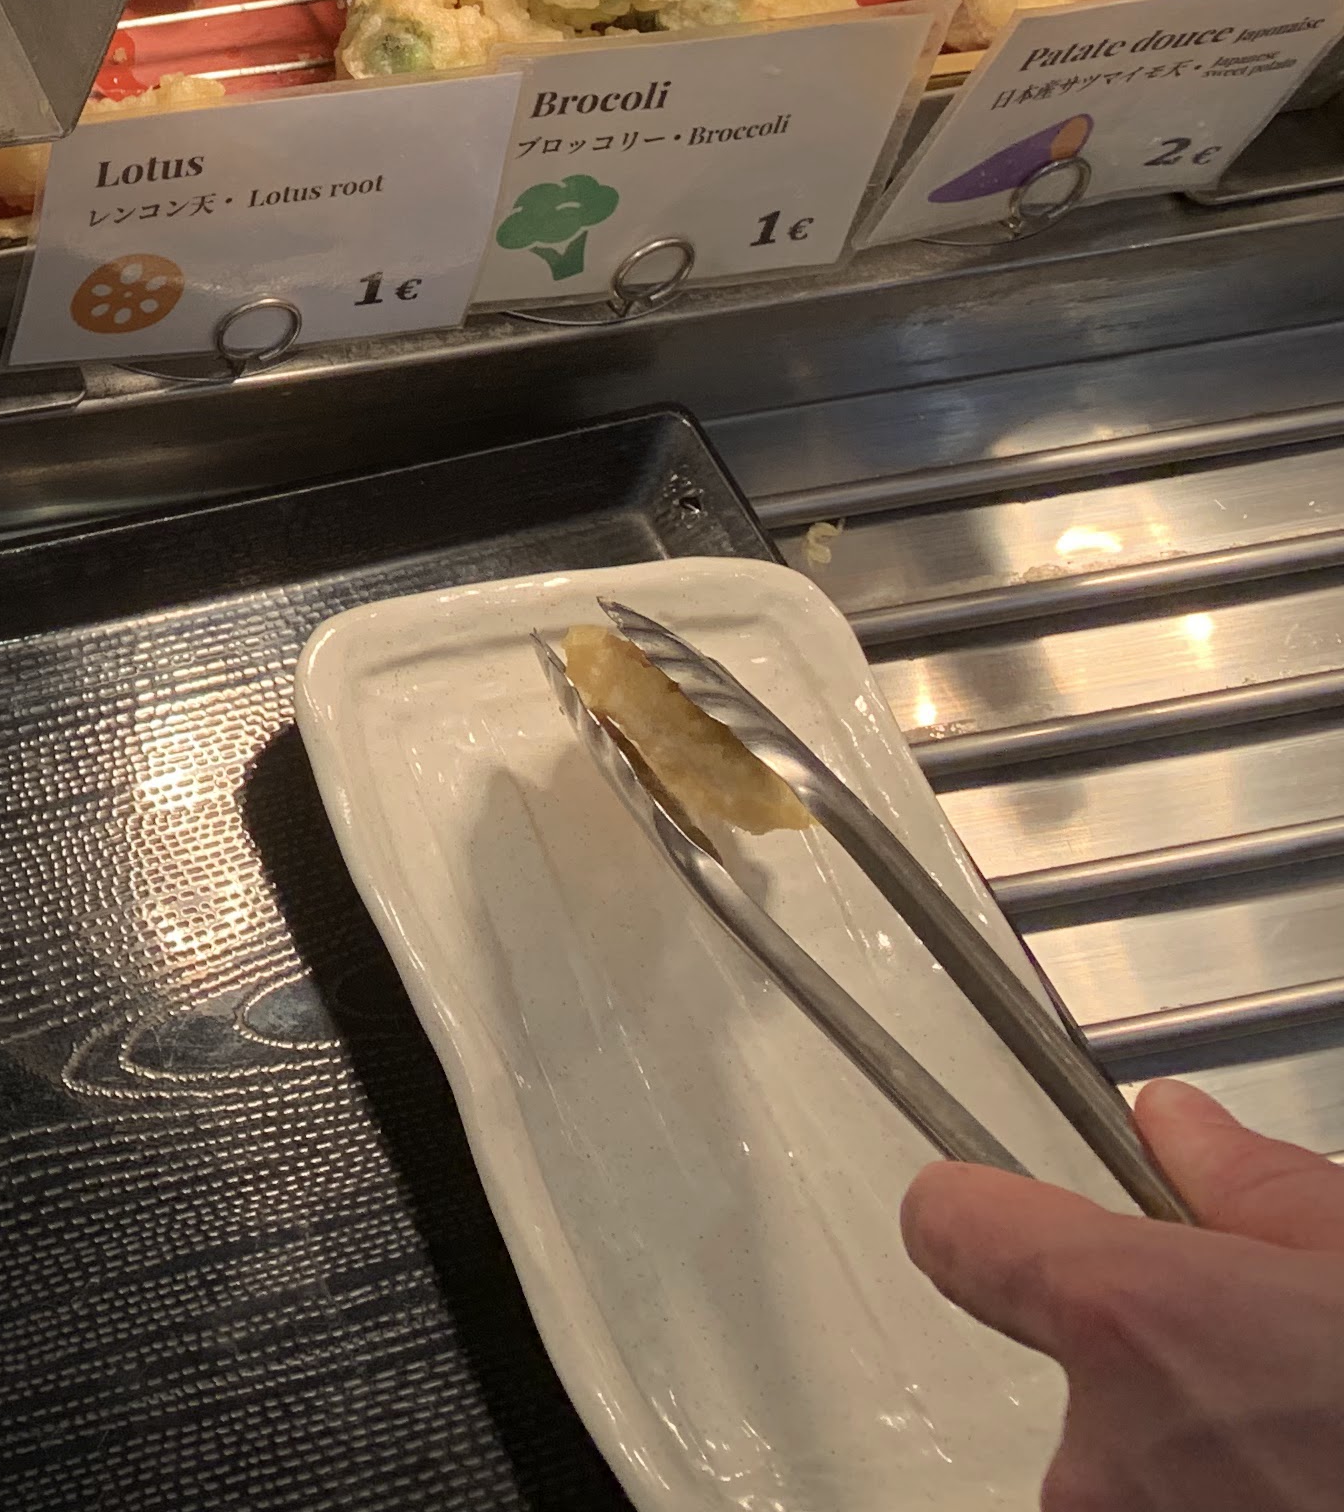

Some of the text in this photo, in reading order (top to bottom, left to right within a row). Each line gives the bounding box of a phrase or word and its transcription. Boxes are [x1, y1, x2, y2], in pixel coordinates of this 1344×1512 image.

[1019, 37, 1128, 73] Patate
[1130, 25, 1236, 56] douce
[529, 80, 673, 120] Brocoli
[687, 113, 792, 148] Broccoli
[94, 153, 206, 188] Lotus
[247, 183, 322, 209] Lotus
[329, 173, 385, 197] root
